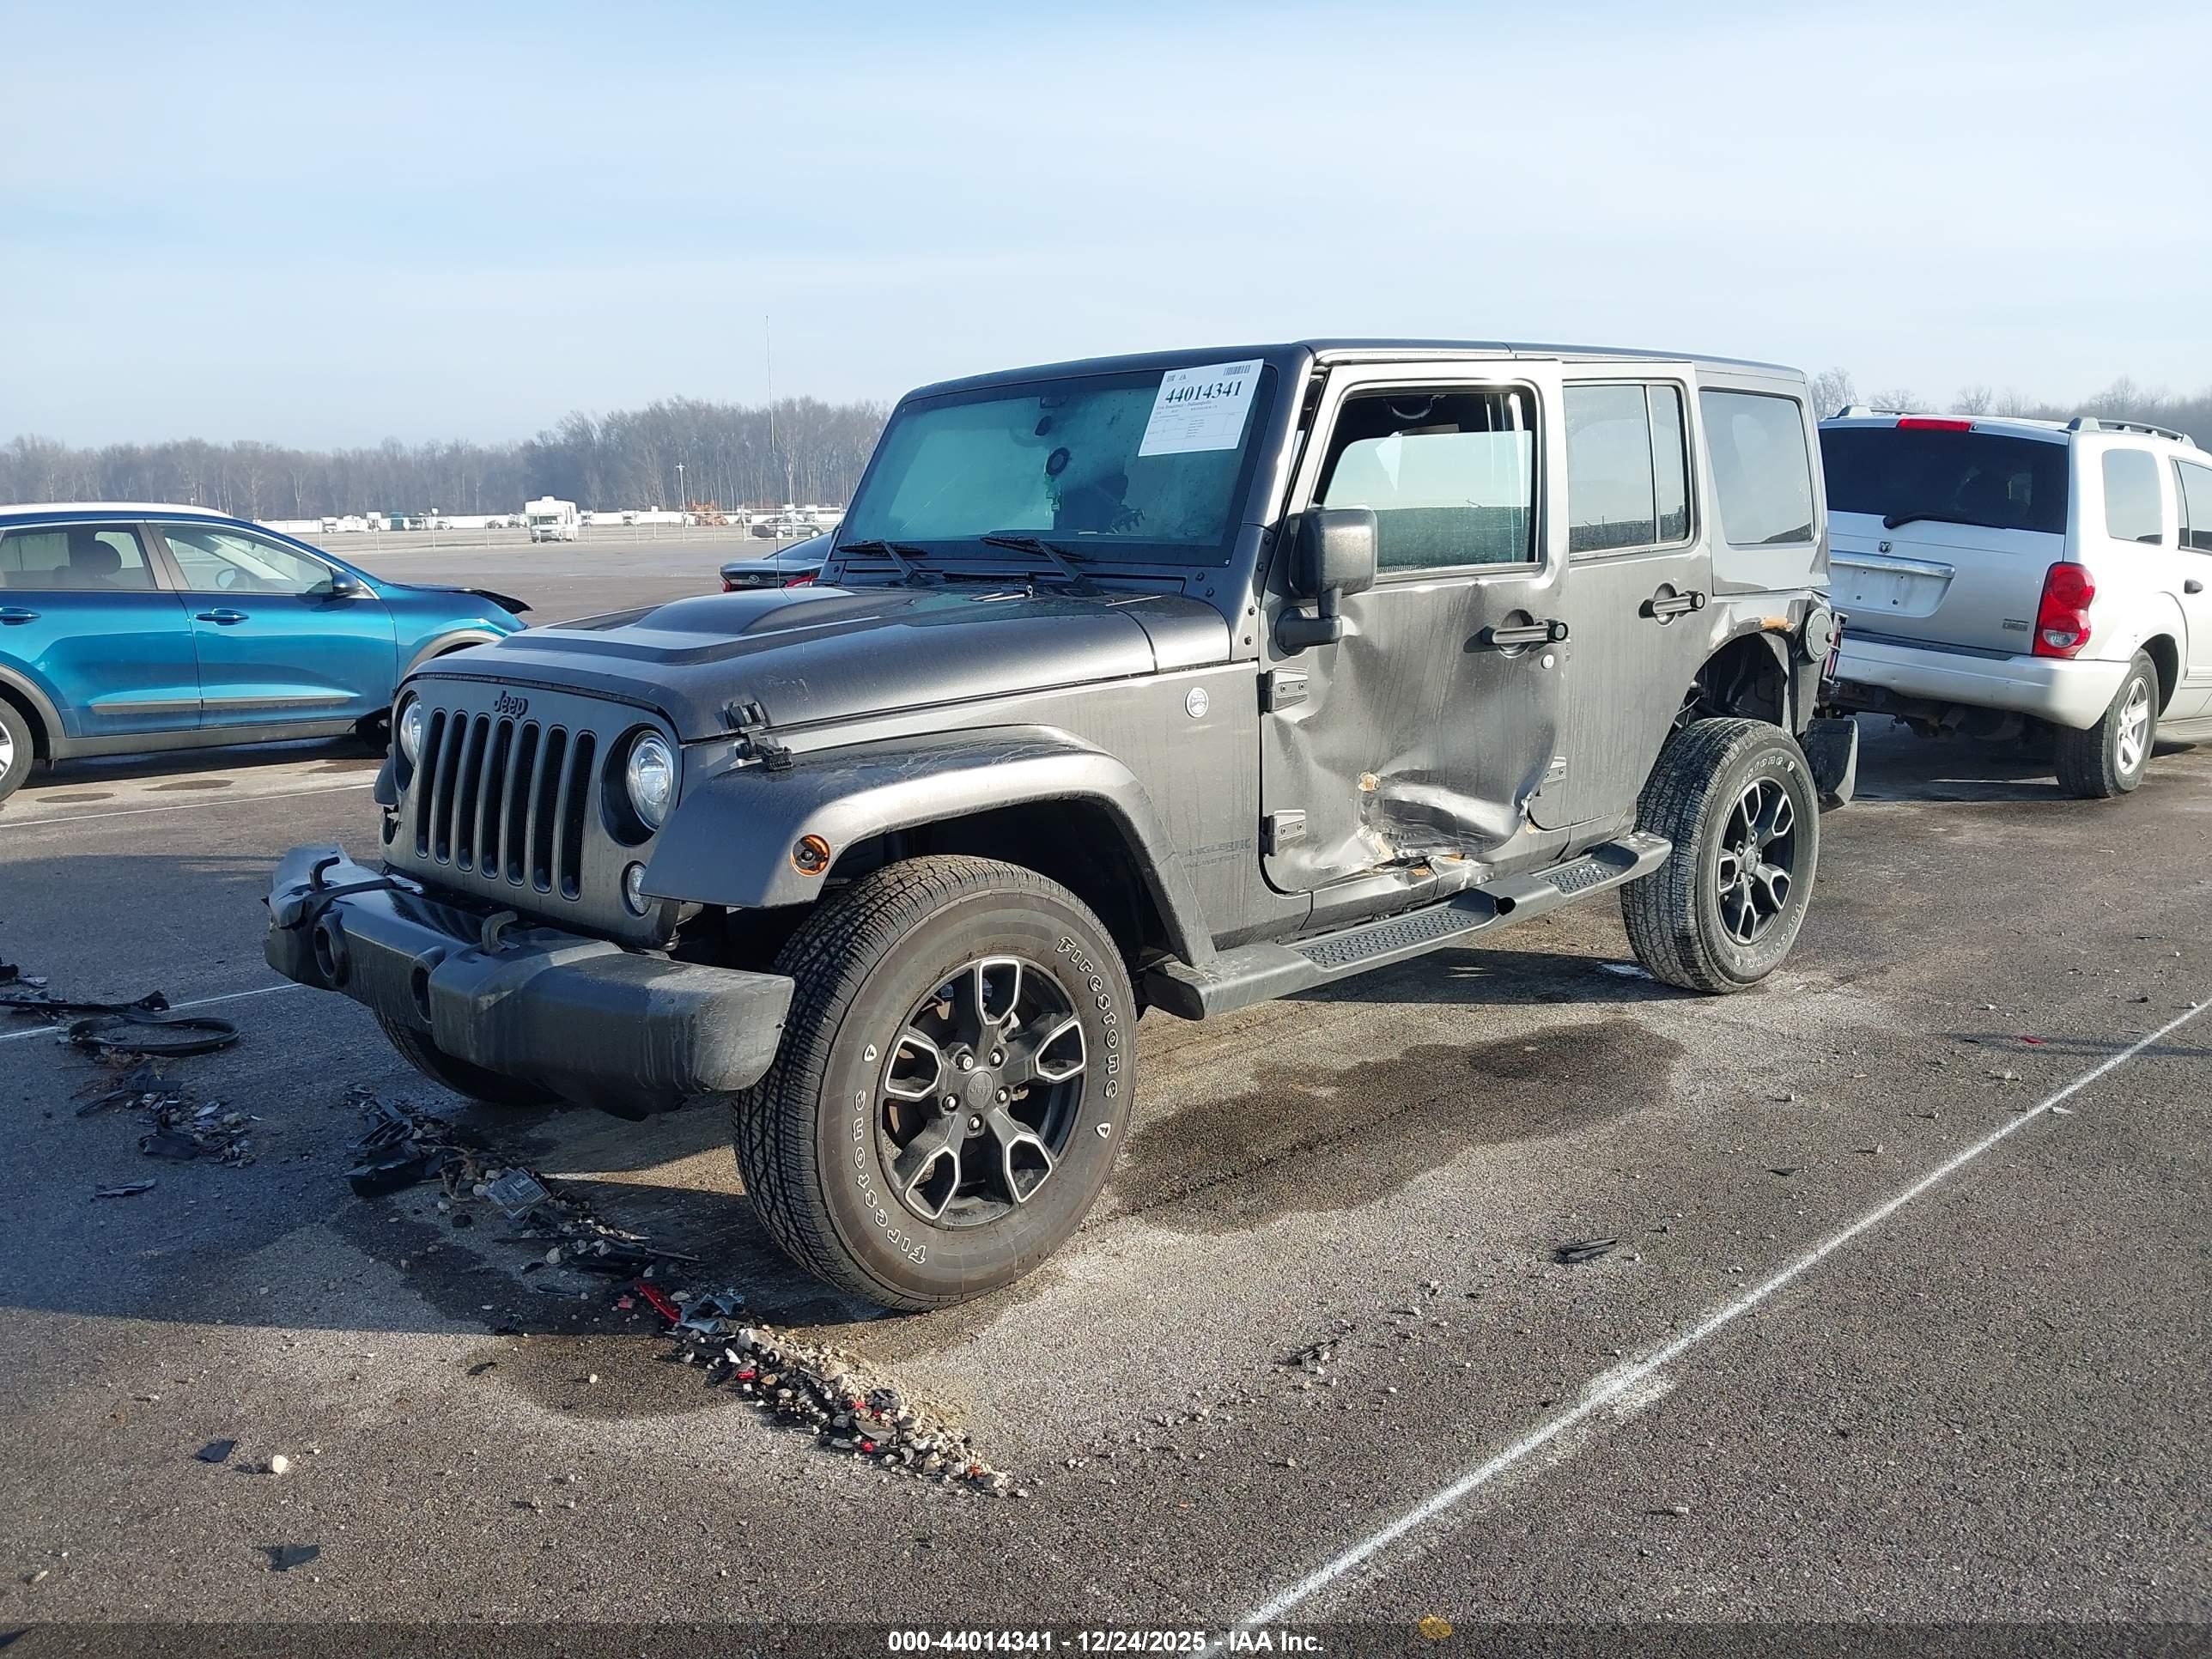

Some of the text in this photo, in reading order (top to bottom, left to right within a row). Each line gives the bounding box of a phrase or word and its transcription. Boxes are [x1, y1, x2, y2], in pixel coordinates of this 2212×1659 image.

[1165, 380, 1242, 403] 44014341
[494, 690, 528, 720] Jeep
[1747, 902, 1803, 969] Firestone
[1055, 935, 1120, 1100] Firestone
[850, 1089, 927, 1265] Firestone
